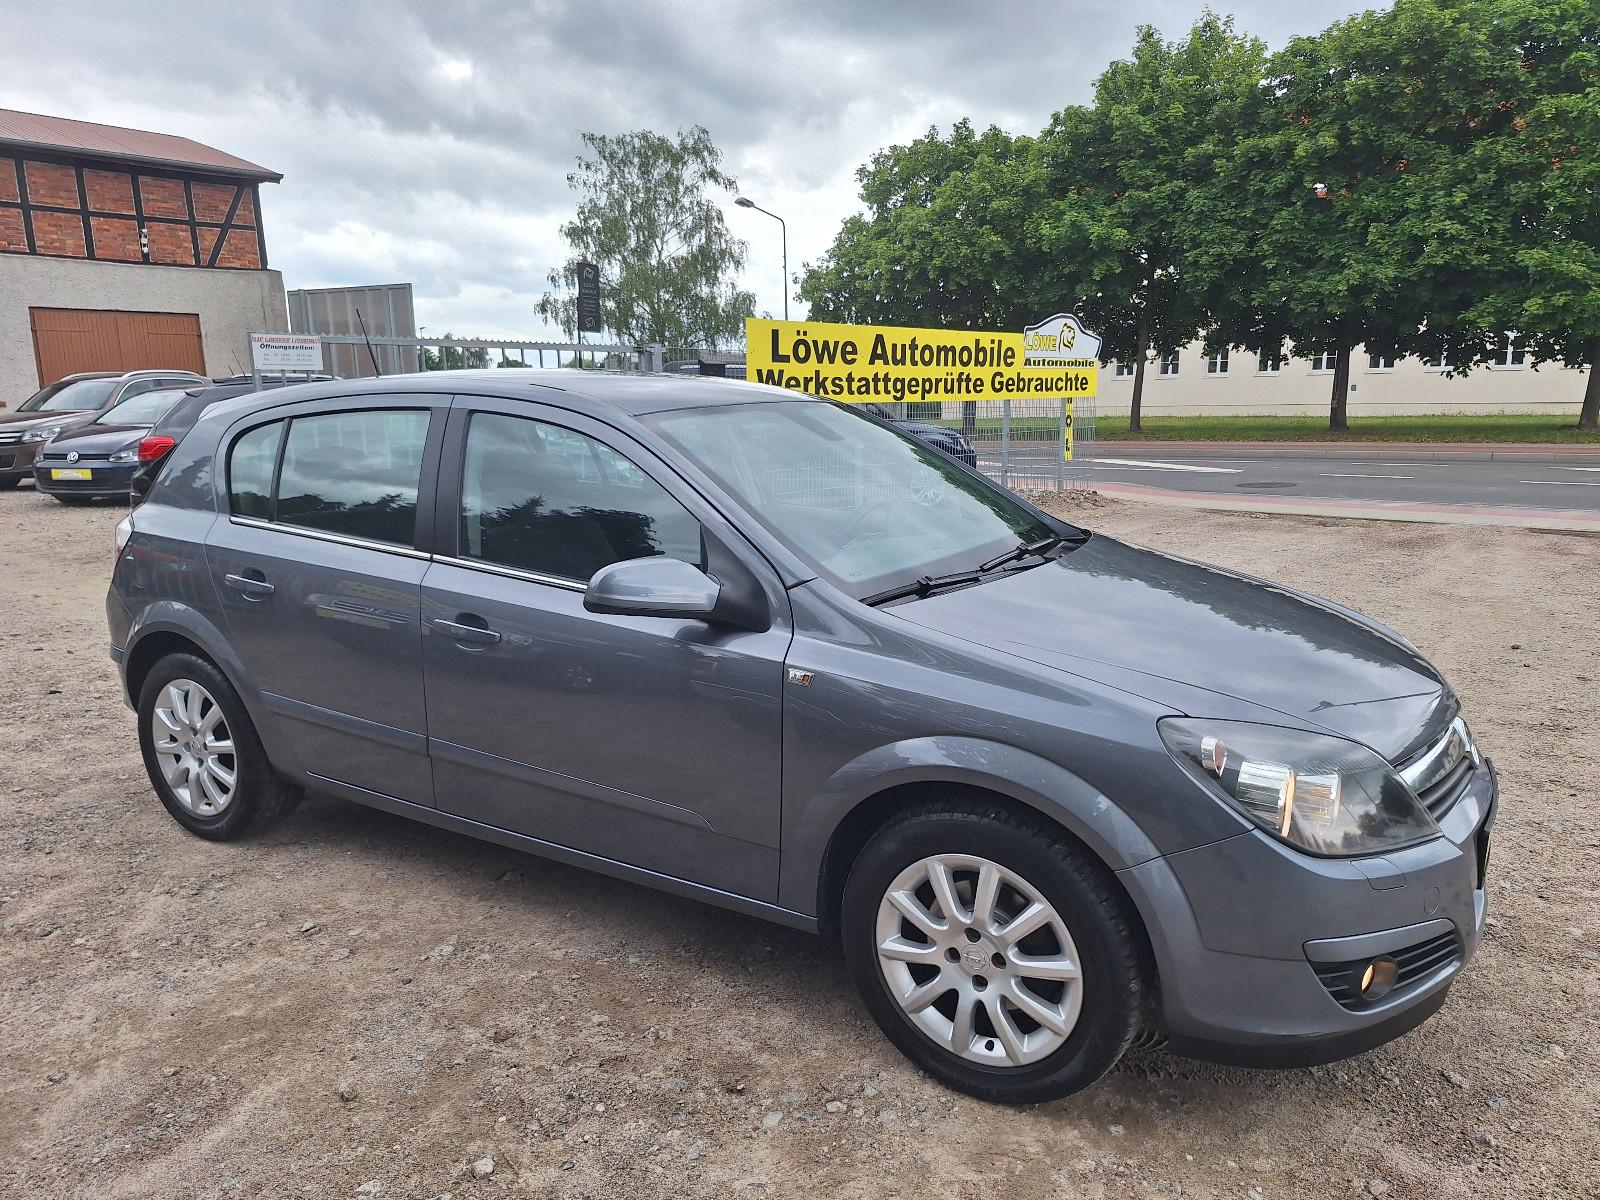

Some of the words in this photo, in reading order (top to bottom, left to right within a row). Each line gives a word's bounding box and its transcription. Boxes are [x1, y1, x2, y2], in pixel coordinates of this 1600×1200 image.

[771, 329, 858, 365] Löwe
[868, 333, 1016, 368] Automobile
[1025, 332, 1057, 351] LÖWE
[1024, 358, 1095, 368] Automobile
[756, 369, 985, 401] Werkstattgeprüfte
[991, 371, 1089, 394] Gebrauchte
